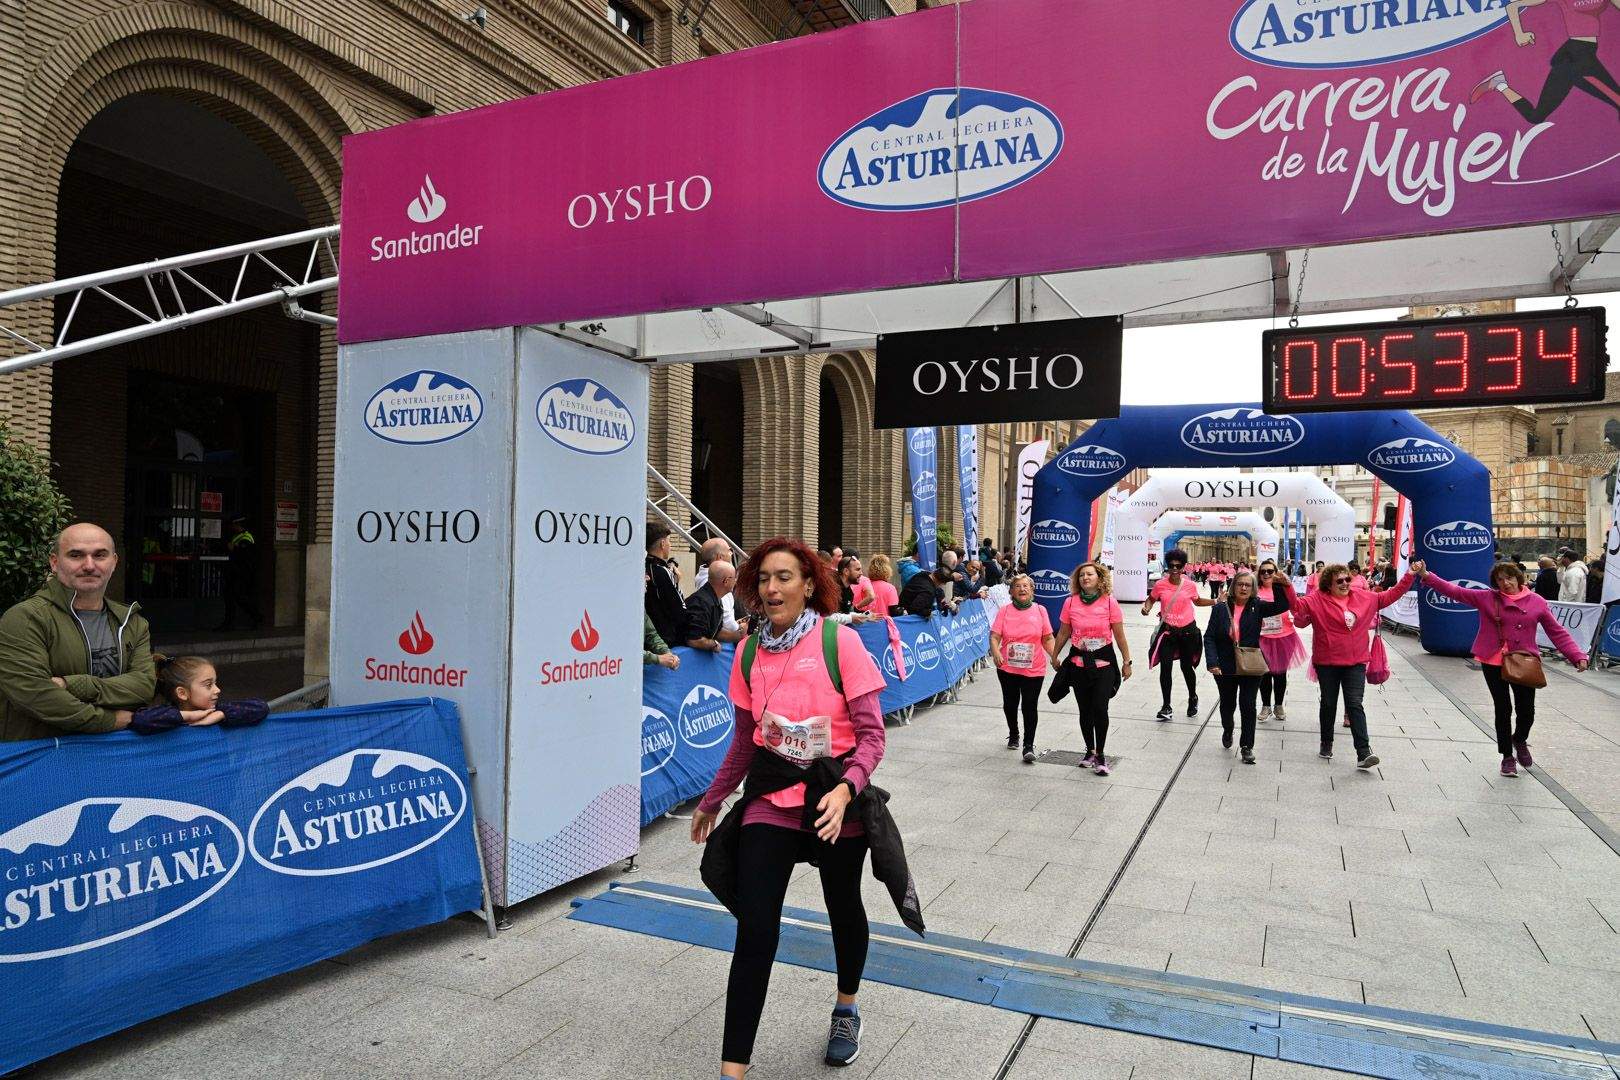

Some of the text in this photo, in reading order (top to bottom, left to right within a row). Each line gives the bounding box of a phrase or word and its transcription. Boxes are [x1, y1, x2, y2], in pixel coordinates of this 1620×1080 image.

[1206, 66, 1451, 139] Carrera
[871, 116, 1034, 152] CENTRAL LECHERA
[835, 133, 1043, 190] ASTURIANA
[1261, 103, 1555, 217] de la Mujer
[568, 175, 712, 229] OYSHO
[370, 223, 483, 261] Santander
[913, 354, 1084, 395] OYSHO
[373, 400, 474, 428] ASTURIANA
[390, 393, 470, 406] CENTRAL LECHERA
[544, 398, 628, 441] ASTURIANA
[1189, 424, 1295, 444] ASTURIANA
[1250, 420, 1290, 428] LECHERA
[1061, 456, 1120, 469] ASTURIANA
[1375, 452, 1450, 465] ASTURIANA
[1185, 480, 1278, 498] OYSHO
[357, 509, 480, 544] OYSHO
[534, 509, 633, 547] OYSHO
[1032, 530, 1076, 542] ASTURIANA
[1428, 534, 1488, 546] ASTURIANA
[1035, 582, 1070, 592] TURIANA
[365, 657, 468, 688] Santander
[541, 656, 622, 685] Santander
[684, 707, 731, 738] ASTURIANA
[785, 736, 806, 750] 016
[787, 748, 803, 757] 7245
[304, 776, 444, 814] CENTRAL LECHERA
[270, 790, 455, 860] ASTURIANA
[6, 823, 213, 881] CENTRAL LECHERA
